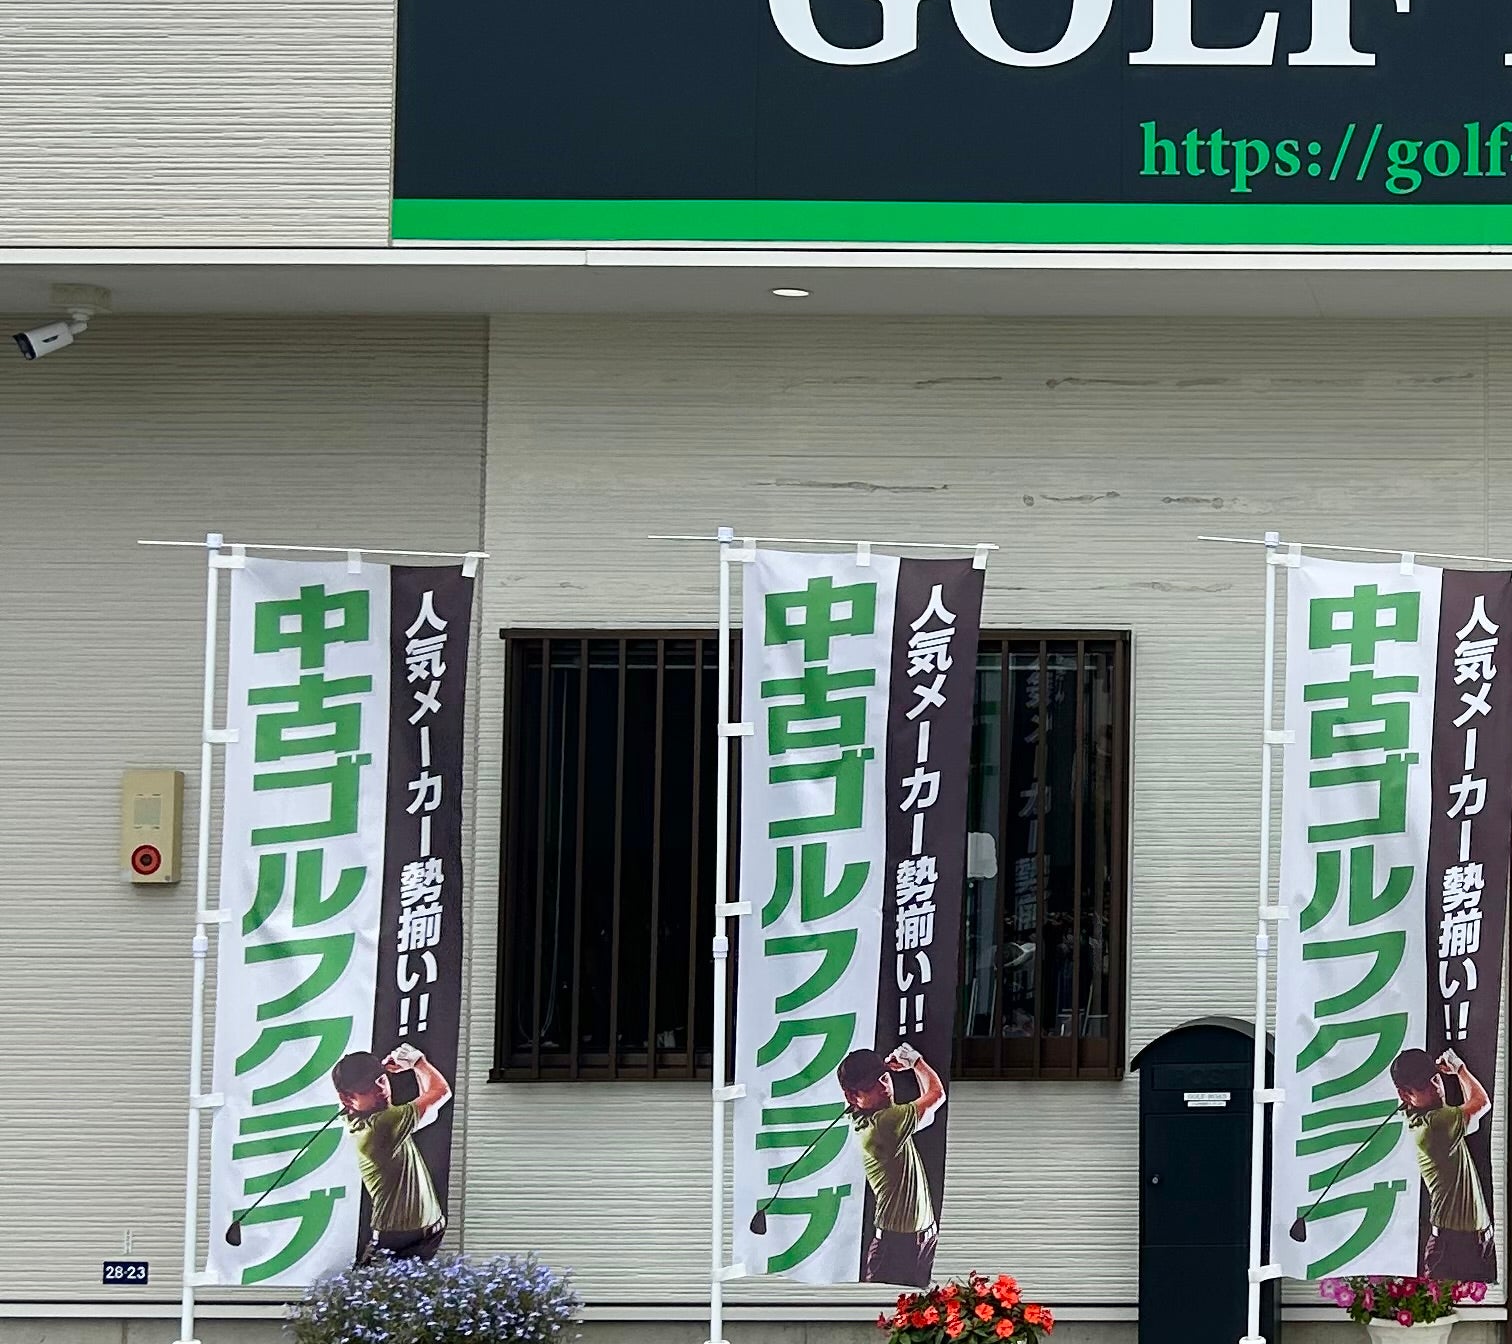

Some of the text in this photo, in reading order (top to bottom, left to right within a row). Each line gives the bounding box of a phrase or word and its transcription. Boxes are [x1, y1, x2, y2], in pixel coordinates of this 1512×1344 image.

[231, 584, 371, 1285] 中古ゴルフクラブ
[756, 576, 877, 1274] 中古ゴルフクラブ
[1295, 584, 1420, 1281] 中古ゴルフクラブ
